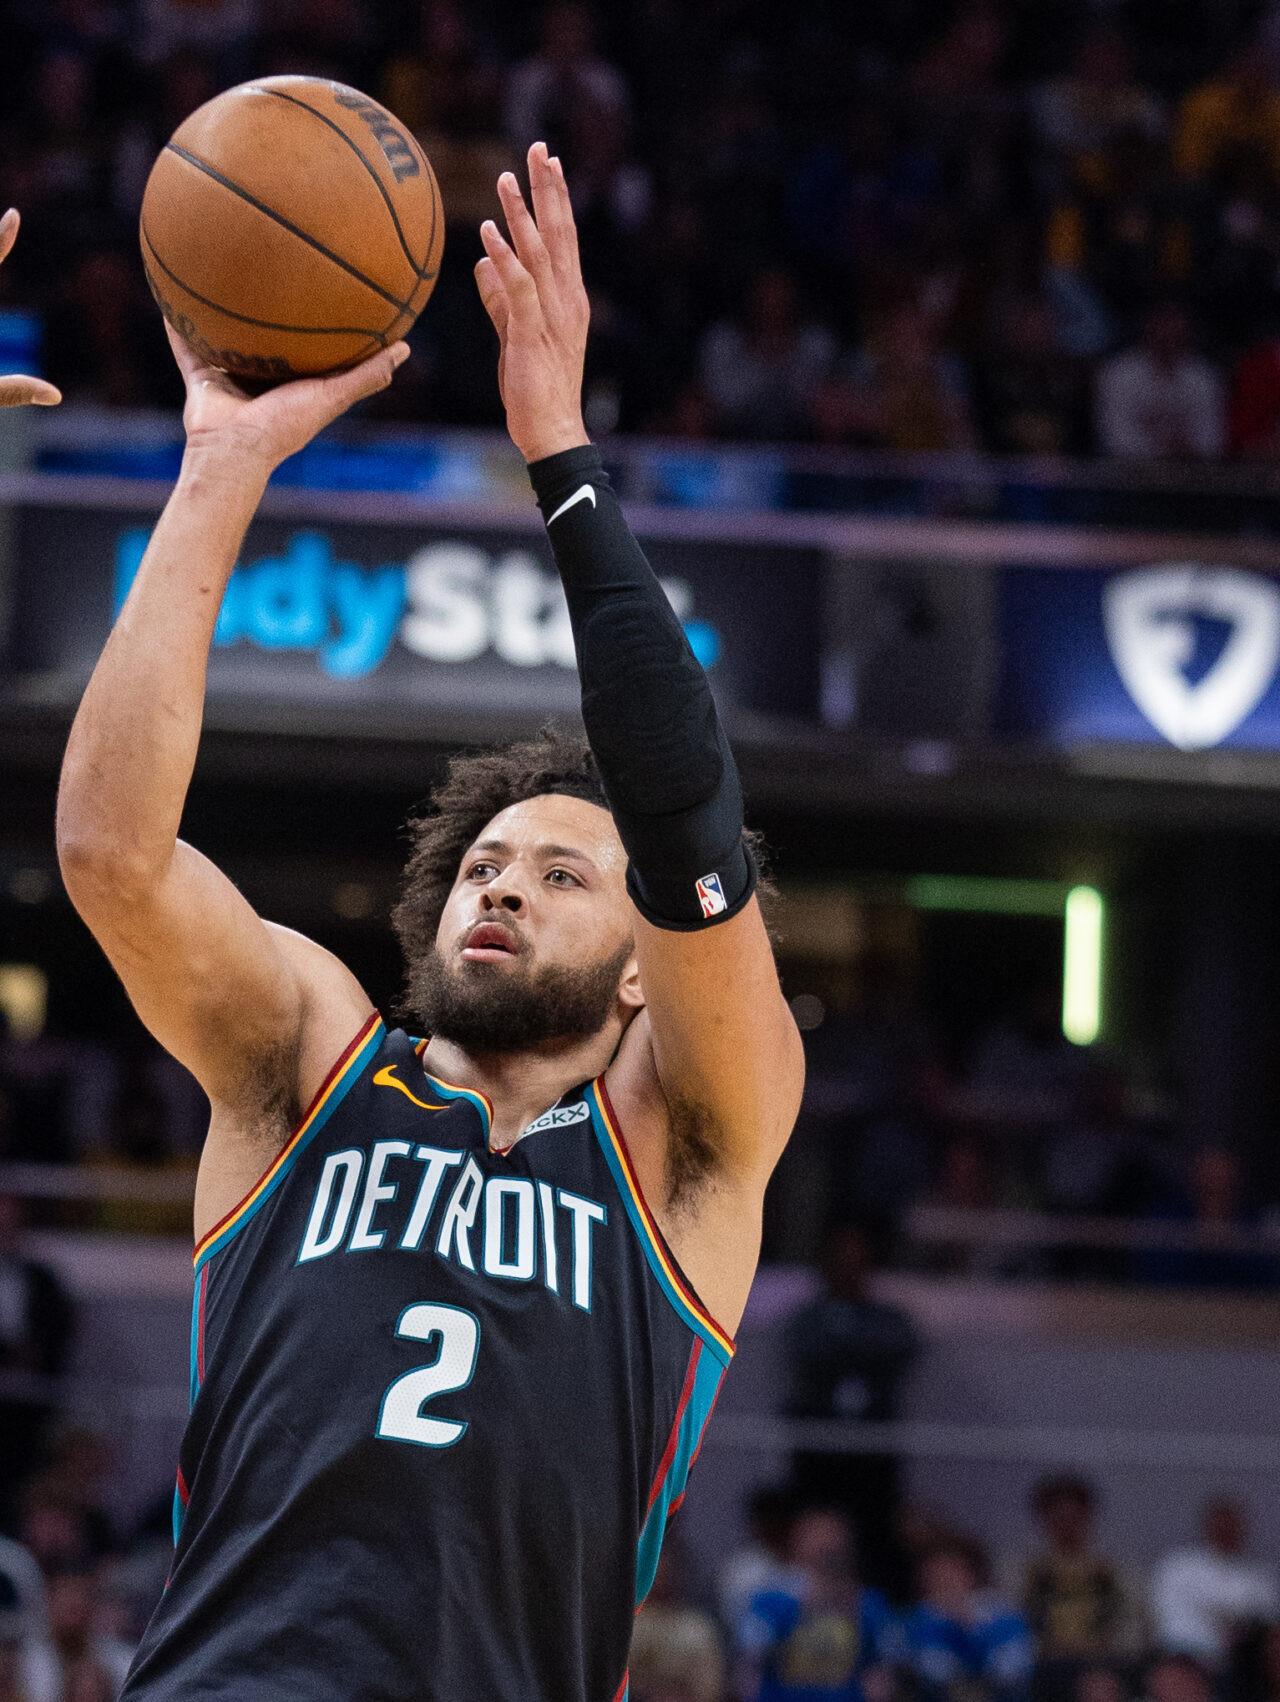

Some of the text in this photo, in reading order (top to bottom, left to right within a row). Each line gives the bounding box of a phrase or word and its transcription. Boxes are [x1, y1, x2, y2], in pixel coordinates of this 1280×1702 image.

[523, 1104, 585, 1135] ockX
[295, 1139, 608, 1314] DETROIT
[375, 1301, 481, 1450] 2
